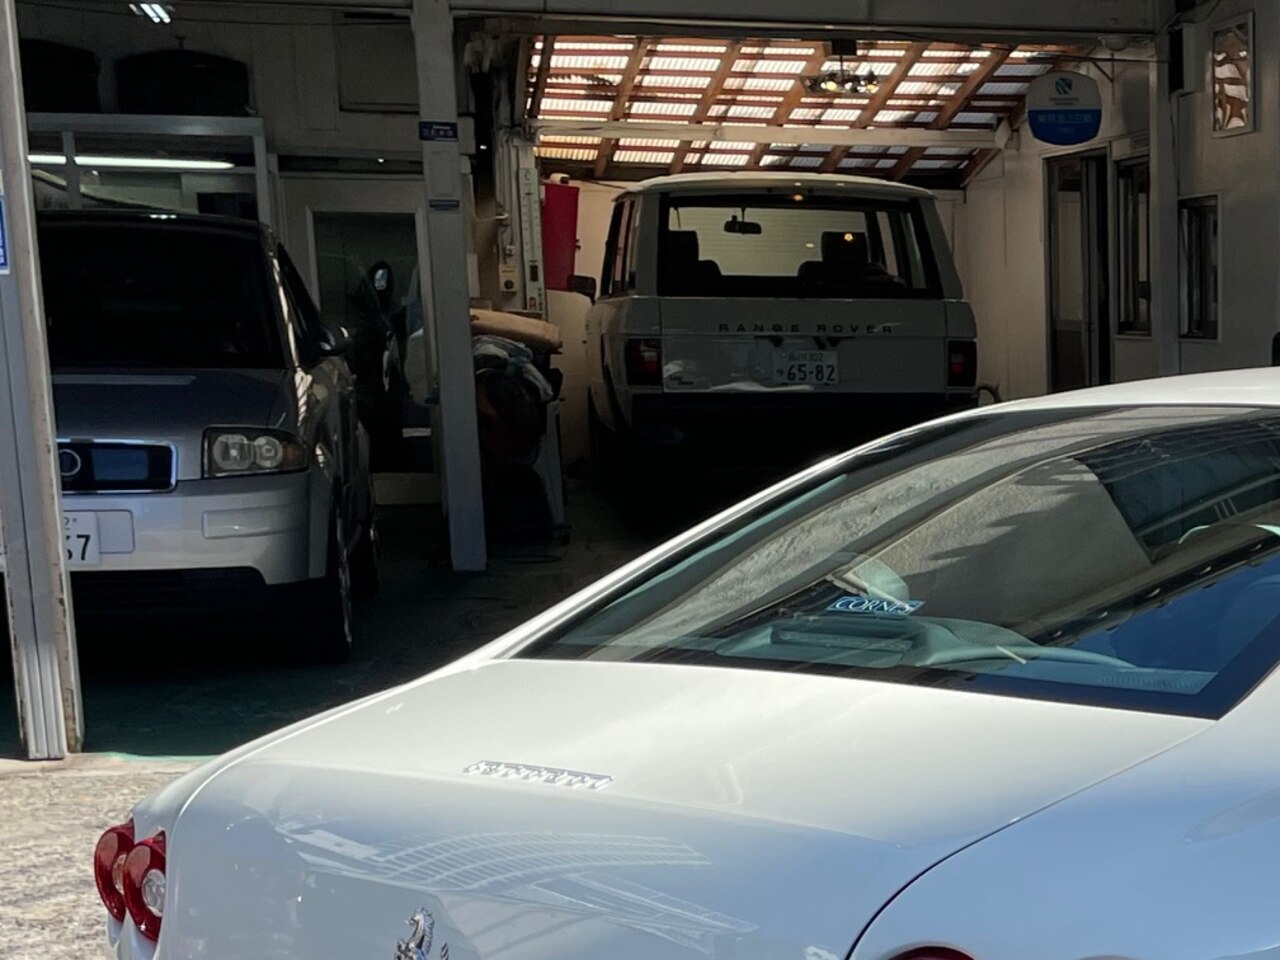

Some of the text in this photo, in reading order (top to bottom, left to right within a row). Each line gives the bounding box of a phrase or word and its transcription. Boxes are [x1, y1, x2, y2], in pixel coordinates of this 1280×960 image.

[718, 323, 893, 334] RANGE ROVER
[787, 363, 836, 381] 65-82
